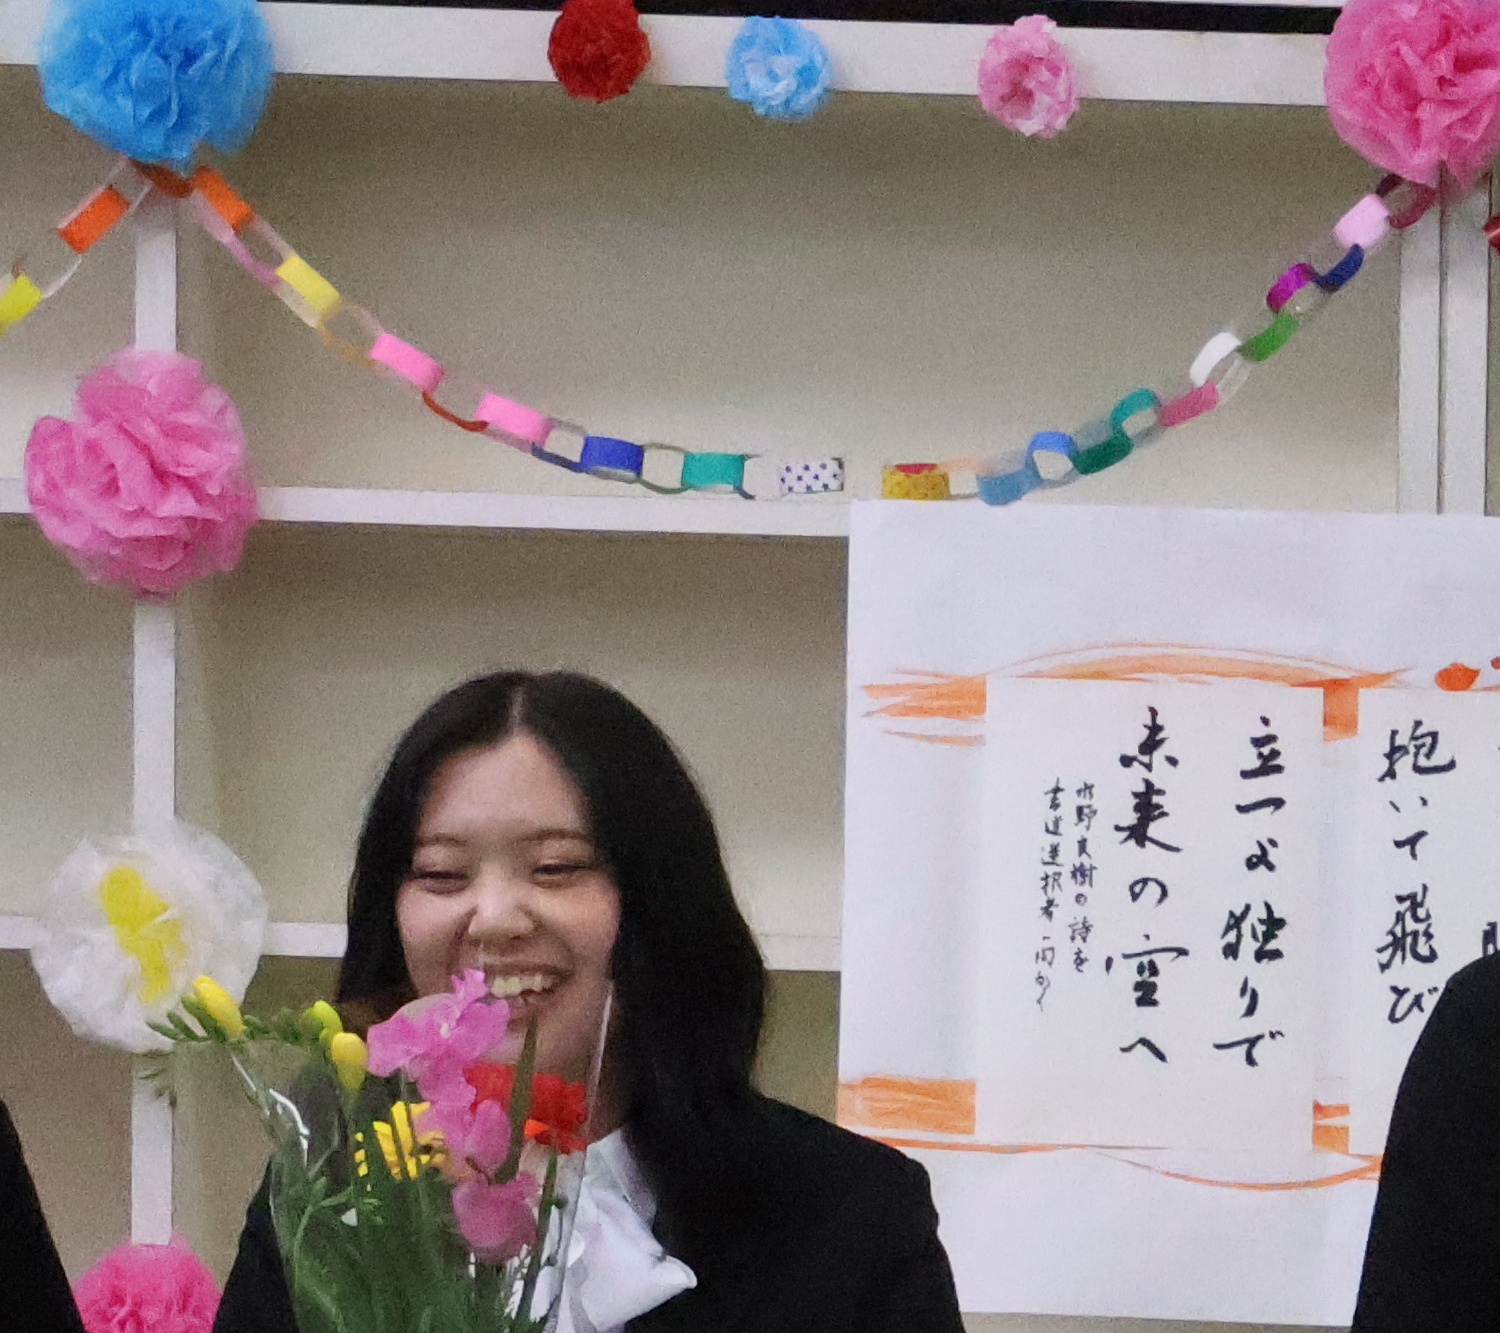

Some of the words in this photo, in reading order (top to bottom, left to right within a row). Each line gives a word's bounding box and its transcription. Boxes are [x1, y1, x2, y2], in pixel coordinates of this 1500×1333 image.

[1104, 705, 1190, 1063] 未来の空へ
[1213, 716, 1287, 1067] 立つよ独りで
[1375, 720, 1456, 1024] 抱いて飛び
